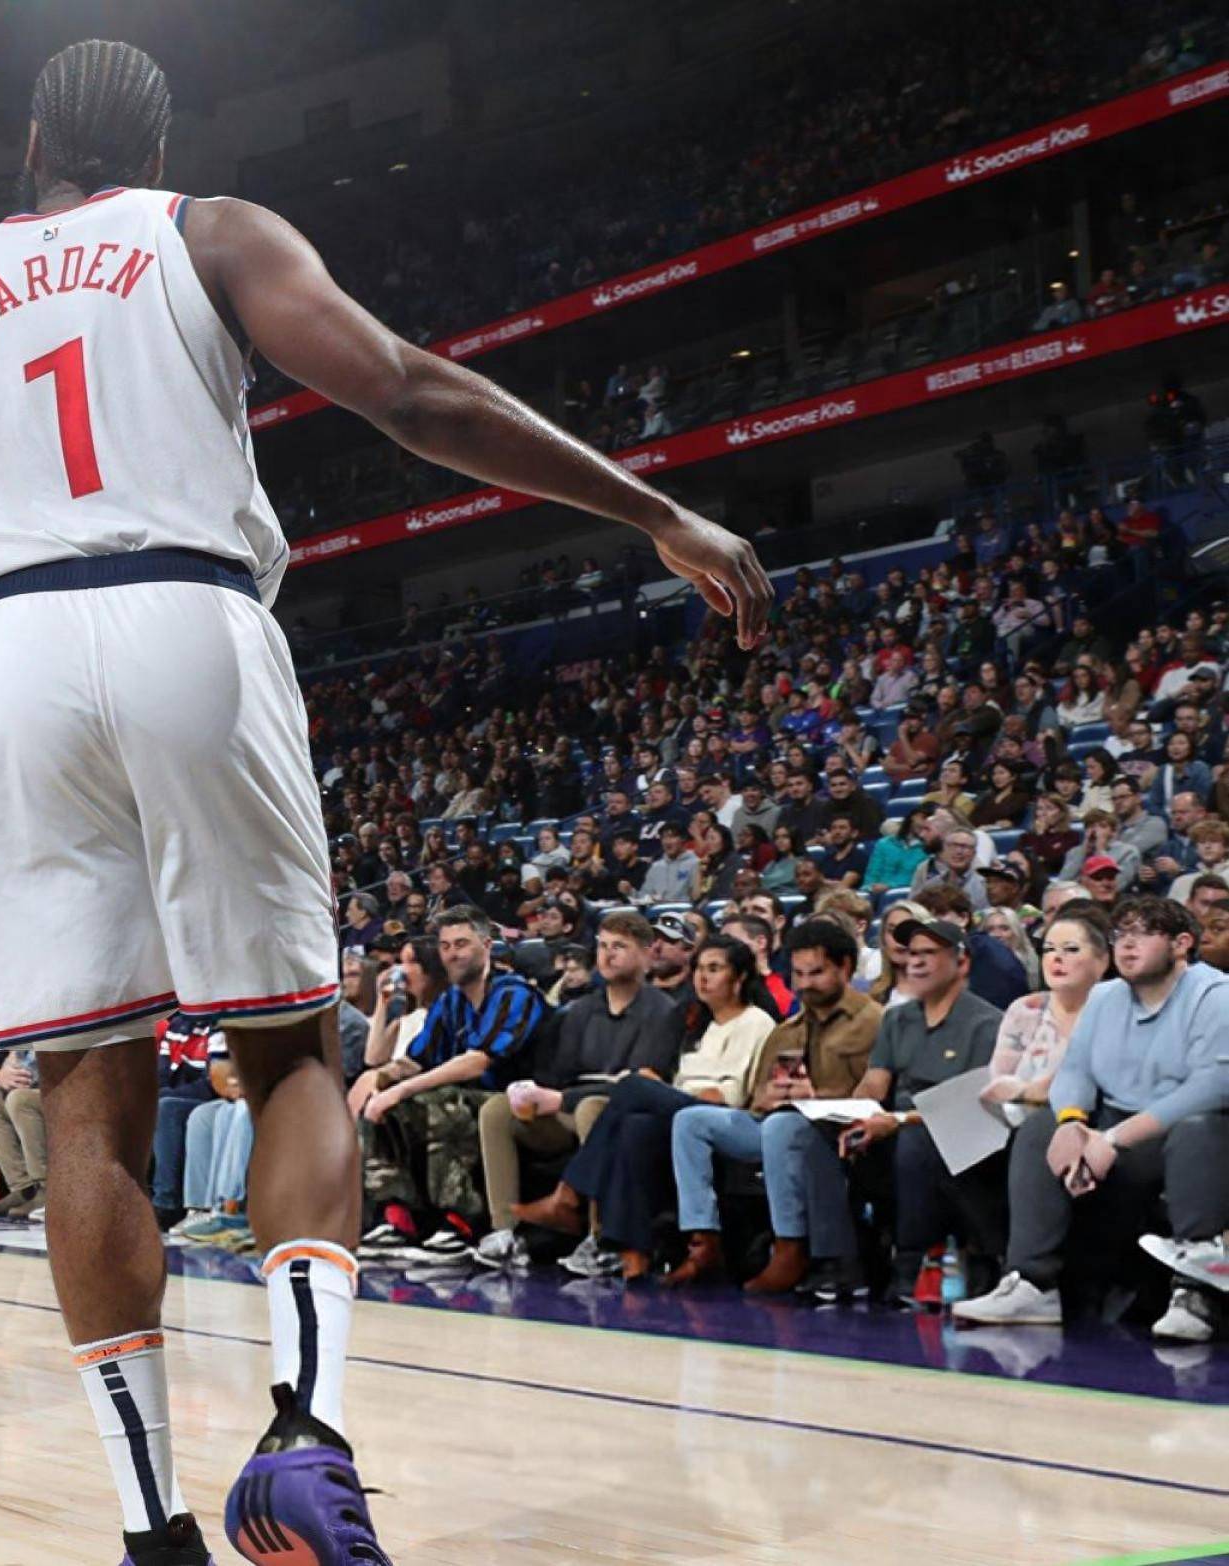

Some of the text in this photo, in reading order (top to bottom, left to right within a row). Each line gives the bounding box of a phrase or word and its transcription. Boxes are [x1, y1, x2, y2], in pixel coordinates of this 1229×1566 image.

[24, 336, 104, 499] 1
[926, 363, 981, 391] WELCOME
[1010, 340, 1064, 370] BLENDER
